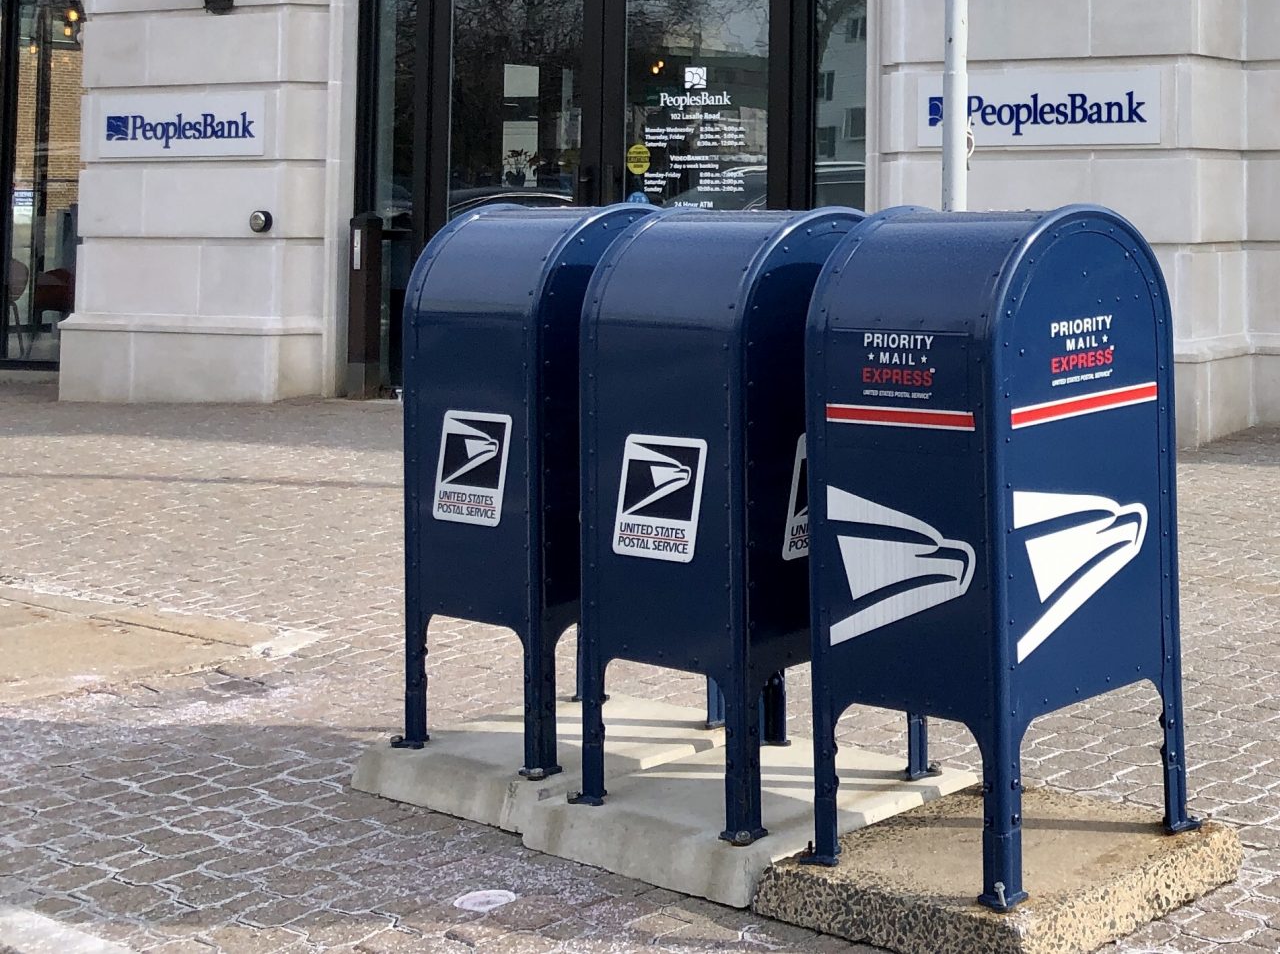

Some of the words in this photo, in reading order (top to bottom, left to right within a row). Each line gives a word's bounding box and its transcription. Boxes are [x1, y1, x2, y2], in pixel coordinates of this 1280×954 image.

[659, 91, 732, 111] PeoplesBank
[703, 112, 721, 120] Road
[967, 91, 1148, 136] PeoplesBank
[129, 111, 255, 149] PeoplesBank
[1050, 314, 1113, 338] PRIORITY
[863, 333, 934, 350] PRIORITY
[1065, 336, 1099, 352] MAIL
[879, 351, 916, 366] MAIL
[1051, 348, 1114, 374] EXPRESS
[862, 366, 933, 387] EXPRESS
[439, 490, 467, 503] UNITED
[467, 493, 494, 506] STATES
[437, 502, 465, 516] POSTAL
[465, 506, 496, 519] SERVICE
[620, 521, 653, 535] UNITED
[654, 525, 686, 539] STATES
[617, 535, 650, 550] POSTAL
[652, 540, 688, 554] SERVICE
